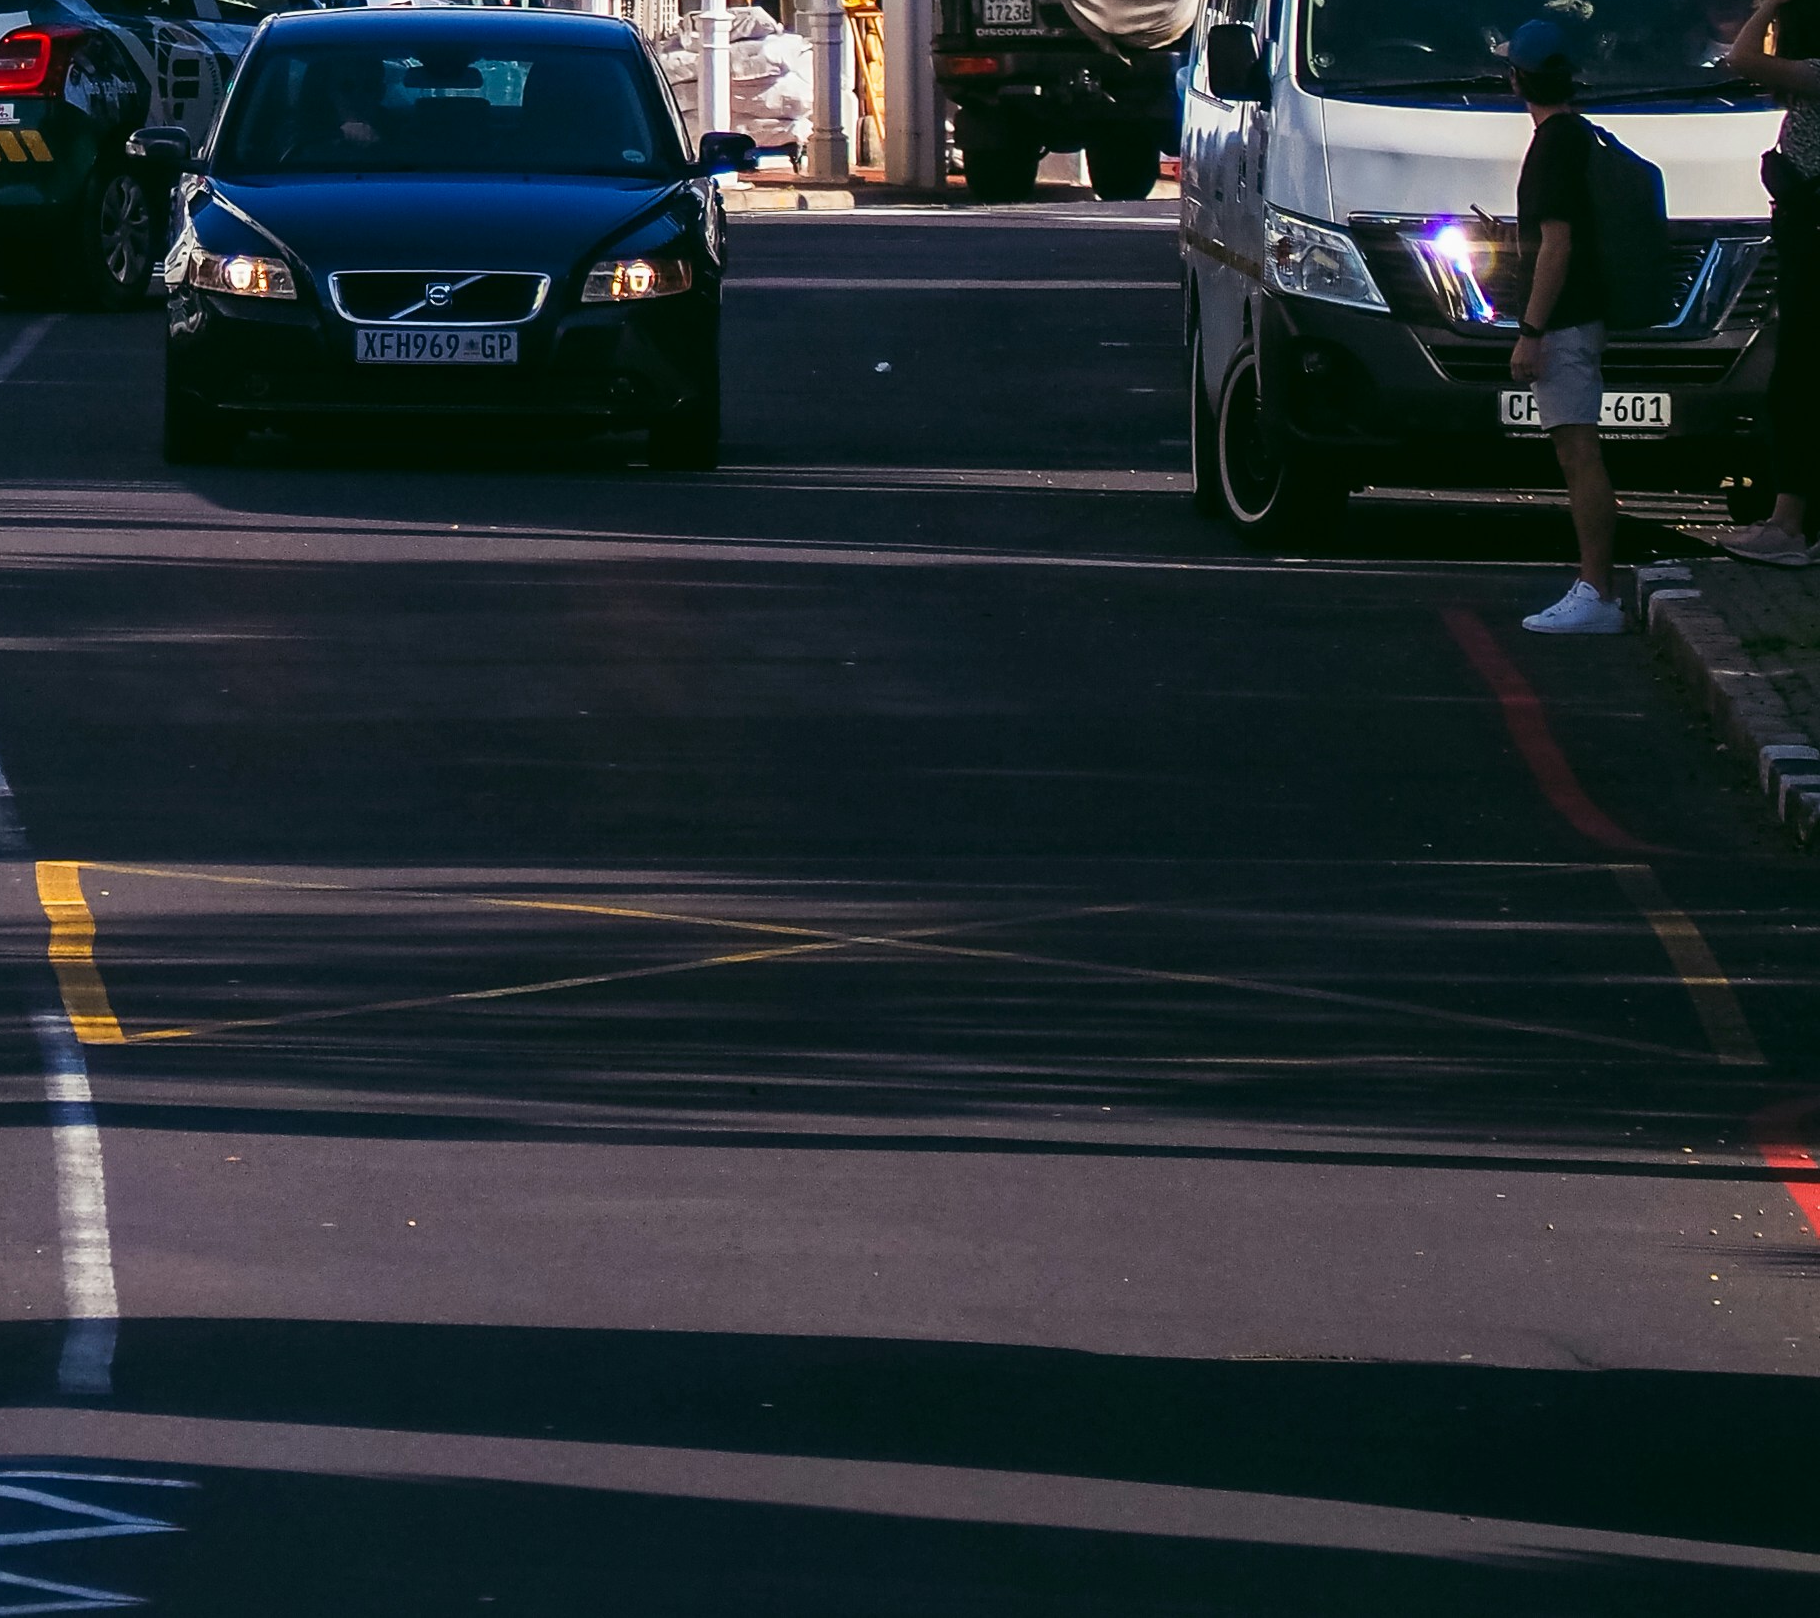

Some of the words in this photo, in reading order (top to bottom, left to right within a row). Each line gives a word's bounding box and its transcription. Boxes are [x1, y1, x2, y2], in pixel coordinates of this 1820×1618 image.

[976, 28, 1044, 37] DISCOVERY
[364, 332, 460, 359] XFH969
[481, 333, 512, 359] GP
[1600, 395, 1664, 422] -601
